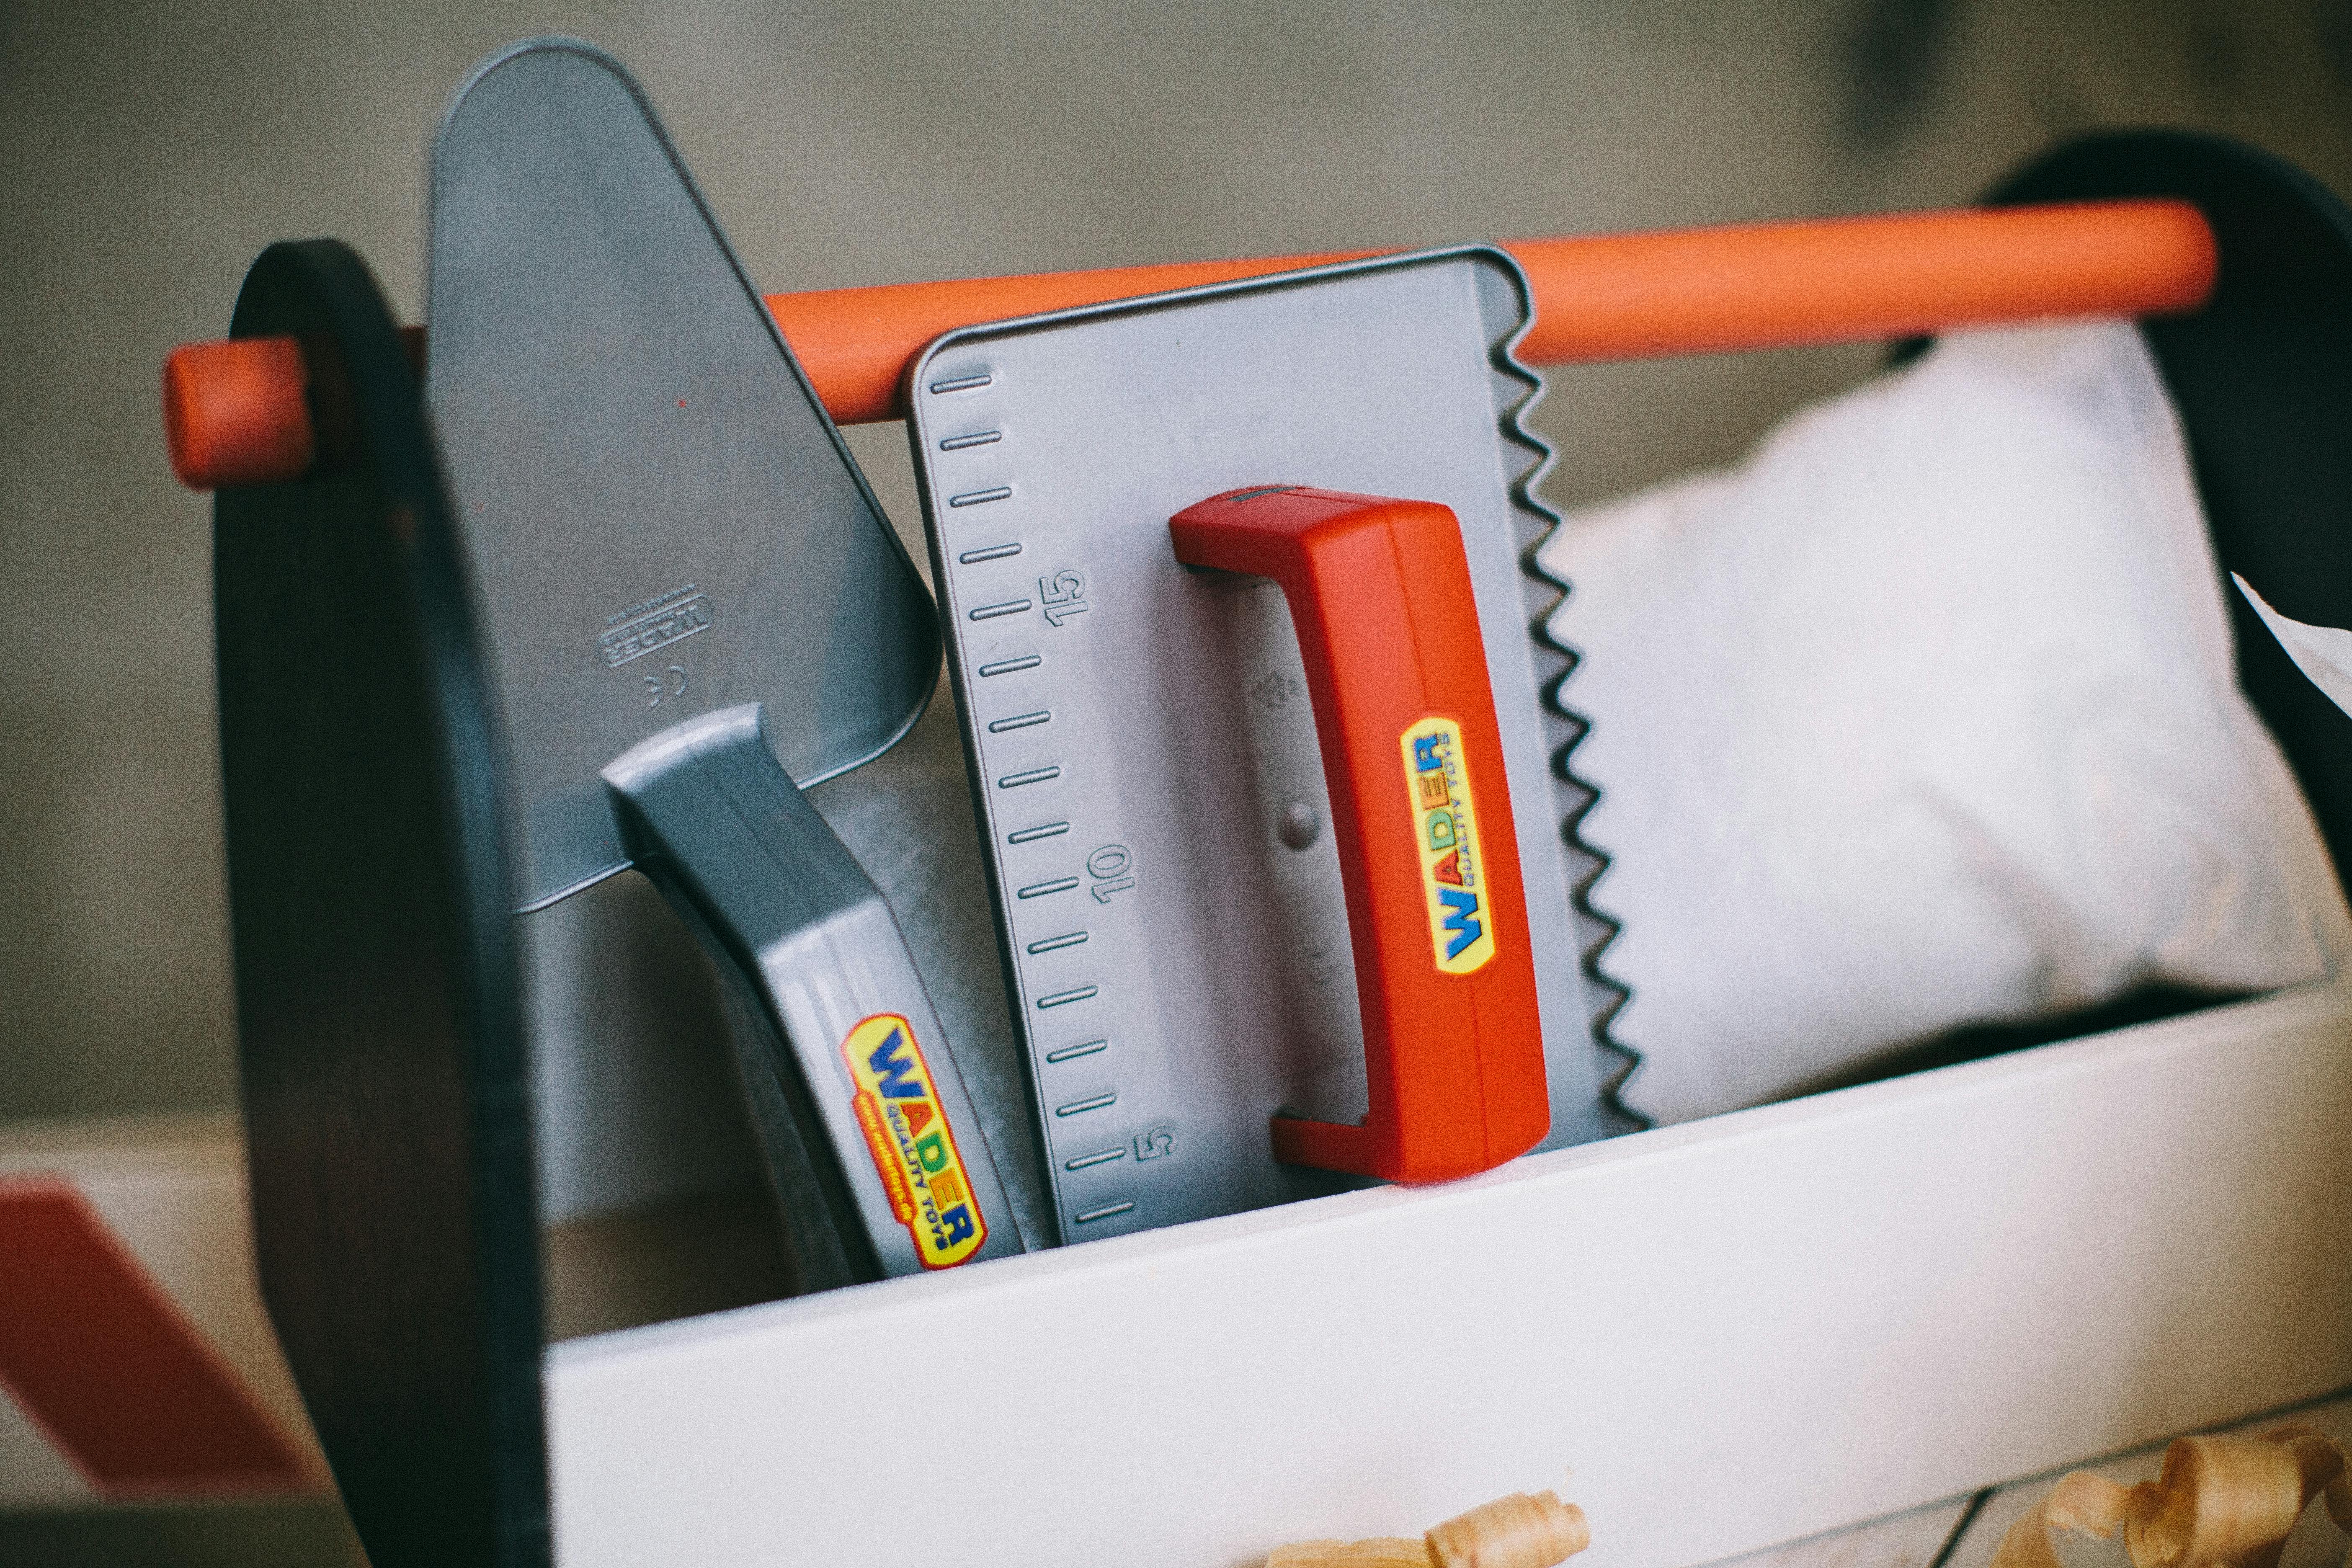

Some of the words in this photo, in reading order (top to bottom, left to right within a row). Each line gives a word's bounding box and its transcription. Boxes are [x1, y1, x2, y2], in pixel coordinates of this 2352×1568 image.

[1039, 570, 1088, 627] 15
[1087, 844, 1135, 904] 10
[1413, 733, 1482, 962] WADER
[1451, 798, 1474, 887] QUALITY
[869, 1027, 975, 1246] WADER
[887, 1104, 928, 1189] QUALITY
[923, 1198, 948, 1251] TOYS
[1132, 1125, 1179, 1162] 5
